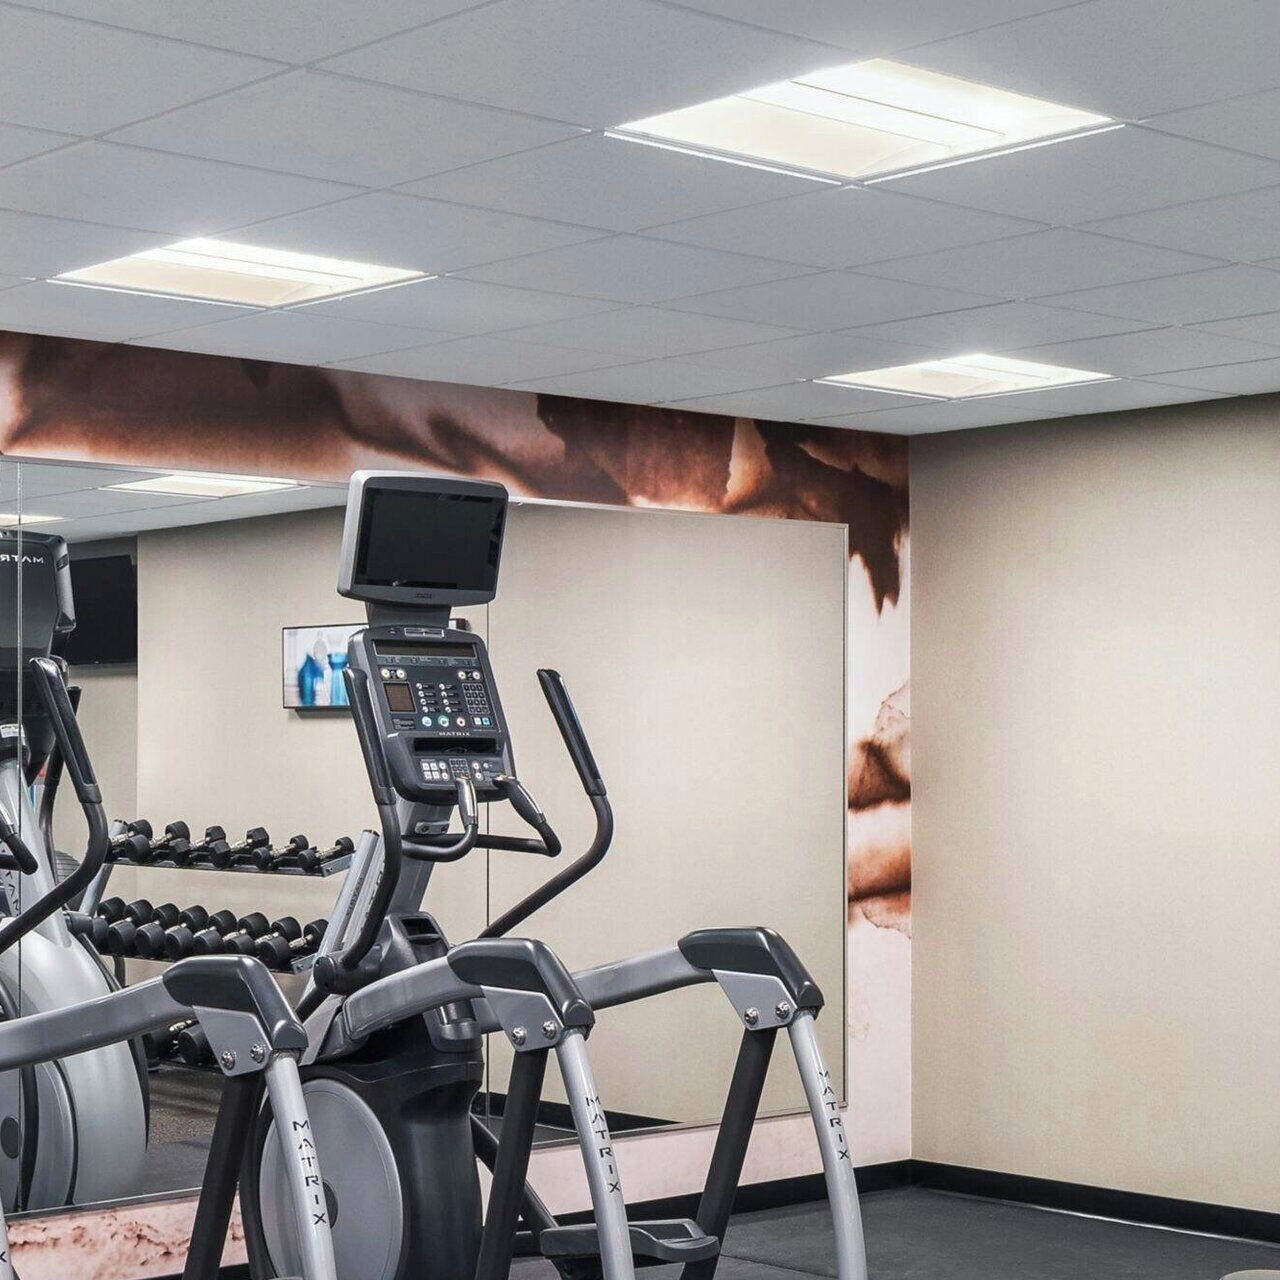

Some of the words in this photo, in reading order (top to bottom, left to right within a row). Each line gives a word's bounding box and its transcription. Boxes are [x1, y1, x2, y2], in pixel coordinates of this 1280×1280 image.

[585, 1096, 621, 1194] MATRIX
[819, 1070, 850, 1161] MATRIX
[292, 1120, 327, 1225] MATRIX
